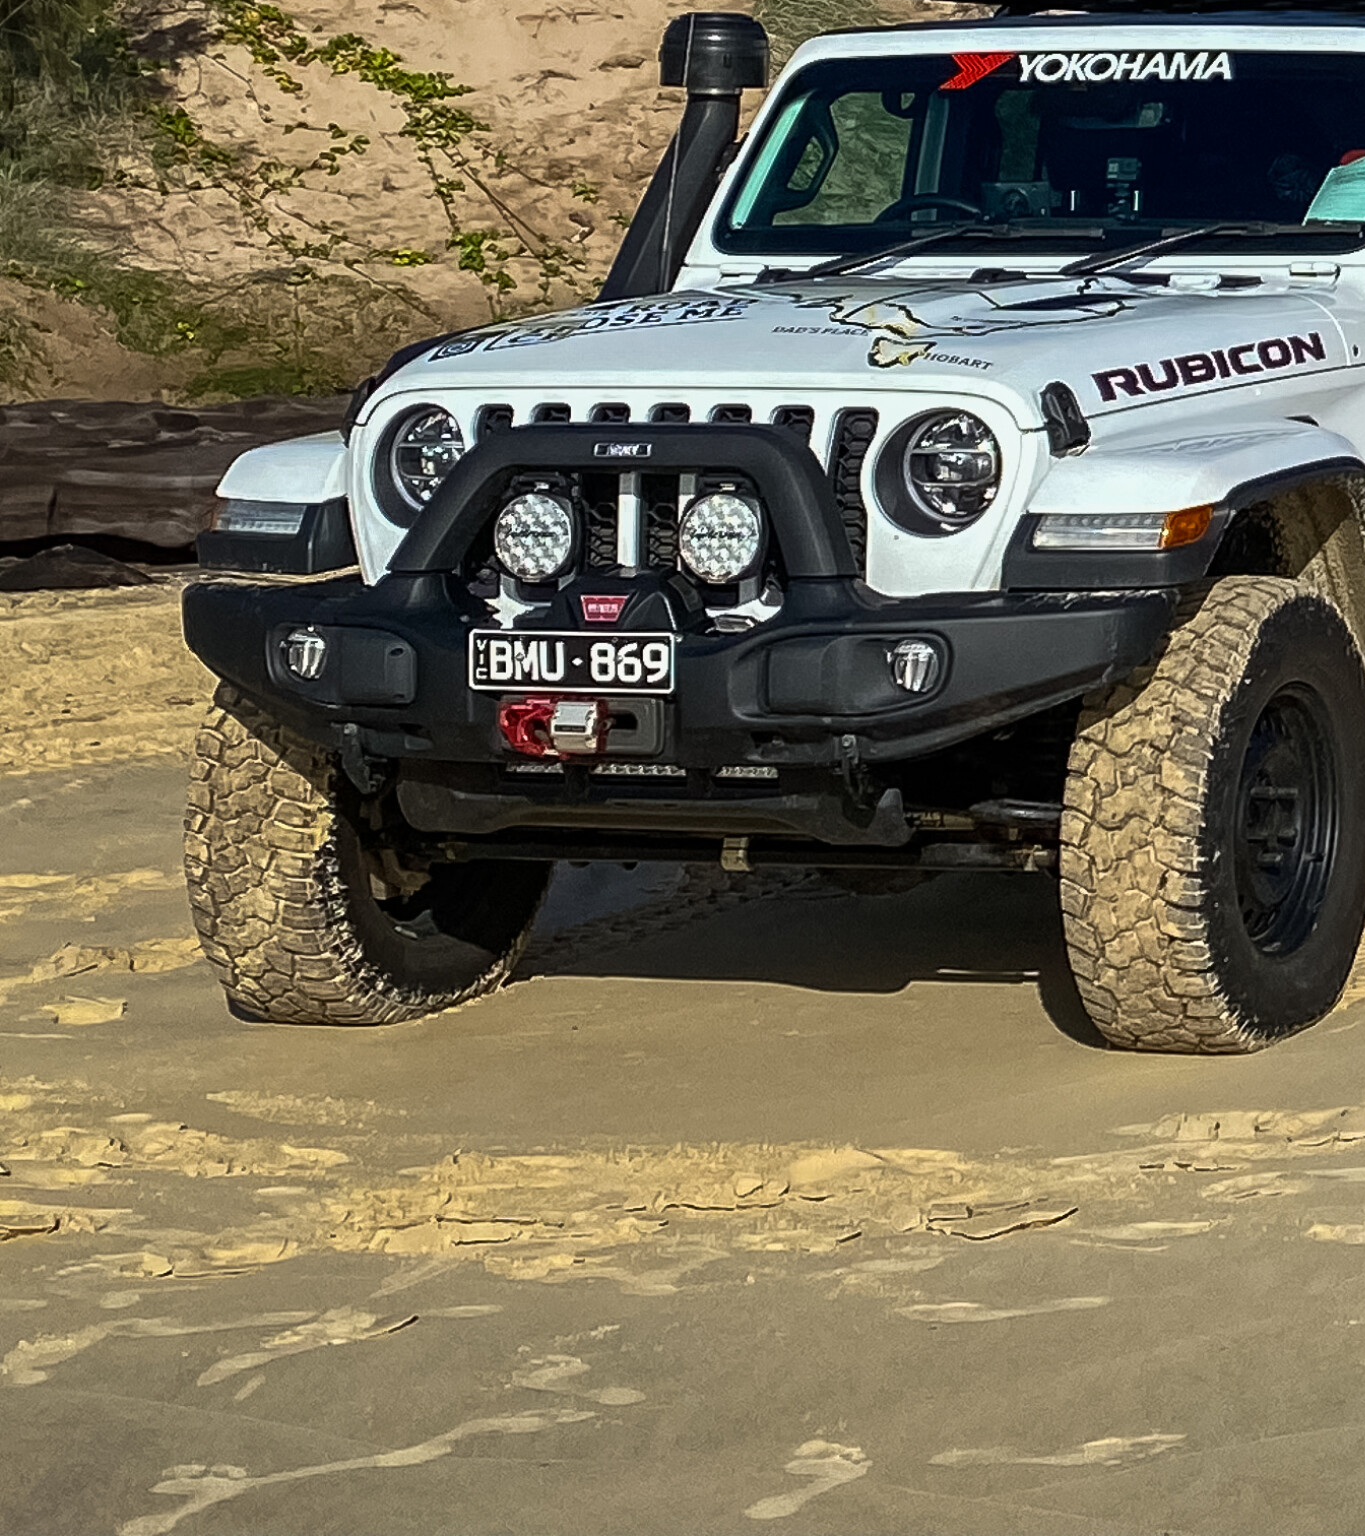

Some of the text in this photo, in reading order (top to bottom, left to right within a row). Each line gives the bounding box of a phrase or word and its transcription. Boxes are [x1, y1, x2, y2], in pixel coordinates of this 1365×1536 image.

[1018, 51, 1233, 82] YOKOHAMA
[922, 351, 994, 371] HOBART
[1090, 331, 1327, 402] RUBICON
